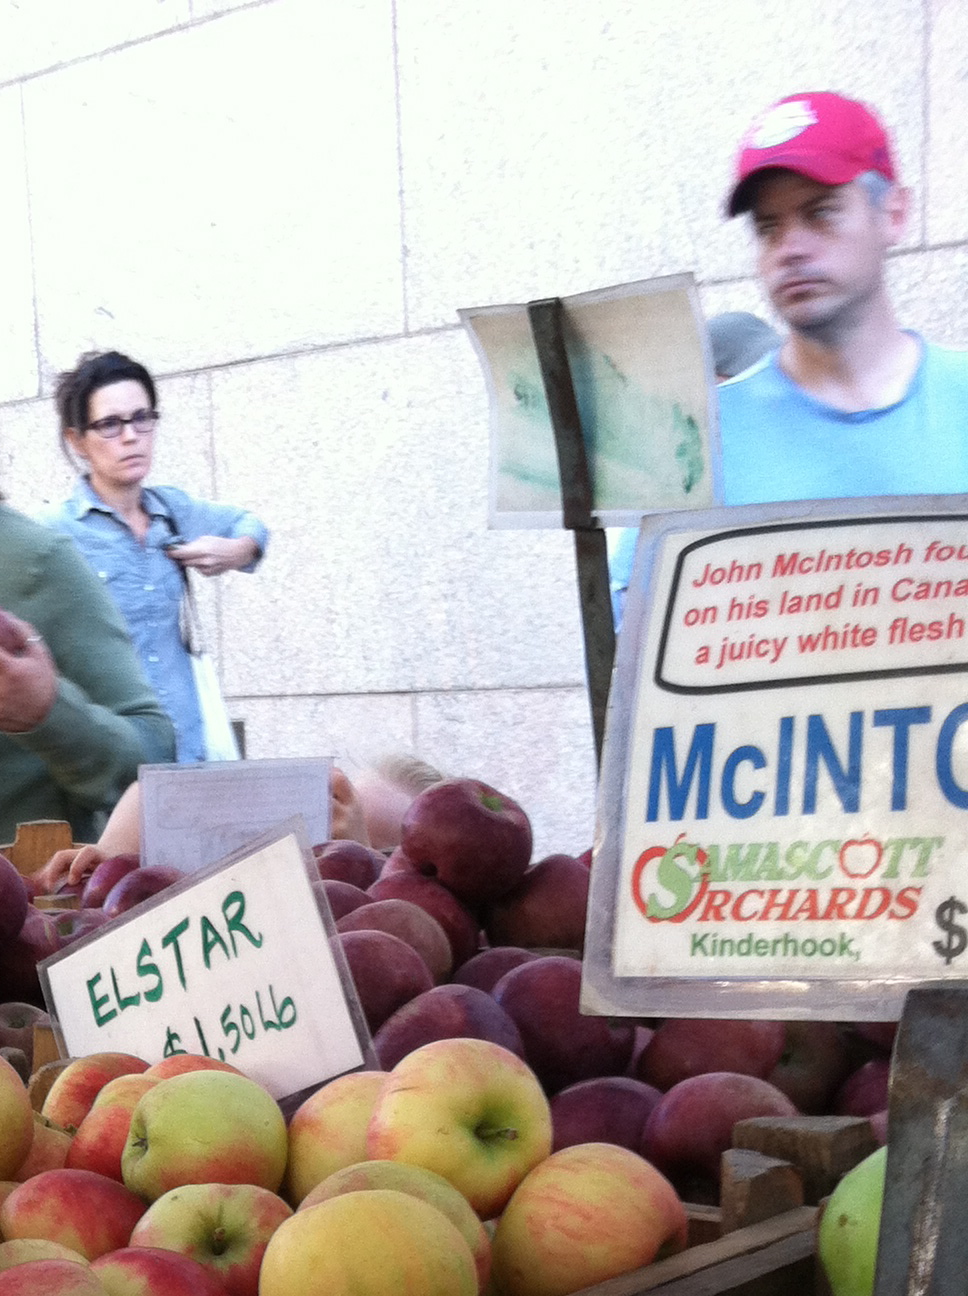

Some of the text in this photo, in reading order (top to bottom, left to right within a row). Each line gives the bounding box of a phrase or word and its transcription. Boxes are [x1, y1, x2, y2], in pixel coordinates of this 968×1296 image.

[692, 560, 762, 587] John
[772, 543, 914, 577] McIntosh
[684, 577, 968, 626] on his land in Cana
[695, 613, 965, 669] a juicy white flesh
[690, 932, 860, 961] Kinderhook,
[933, 895, 968, 965] $
[86, 890, 263, 1027] ELSTAR
